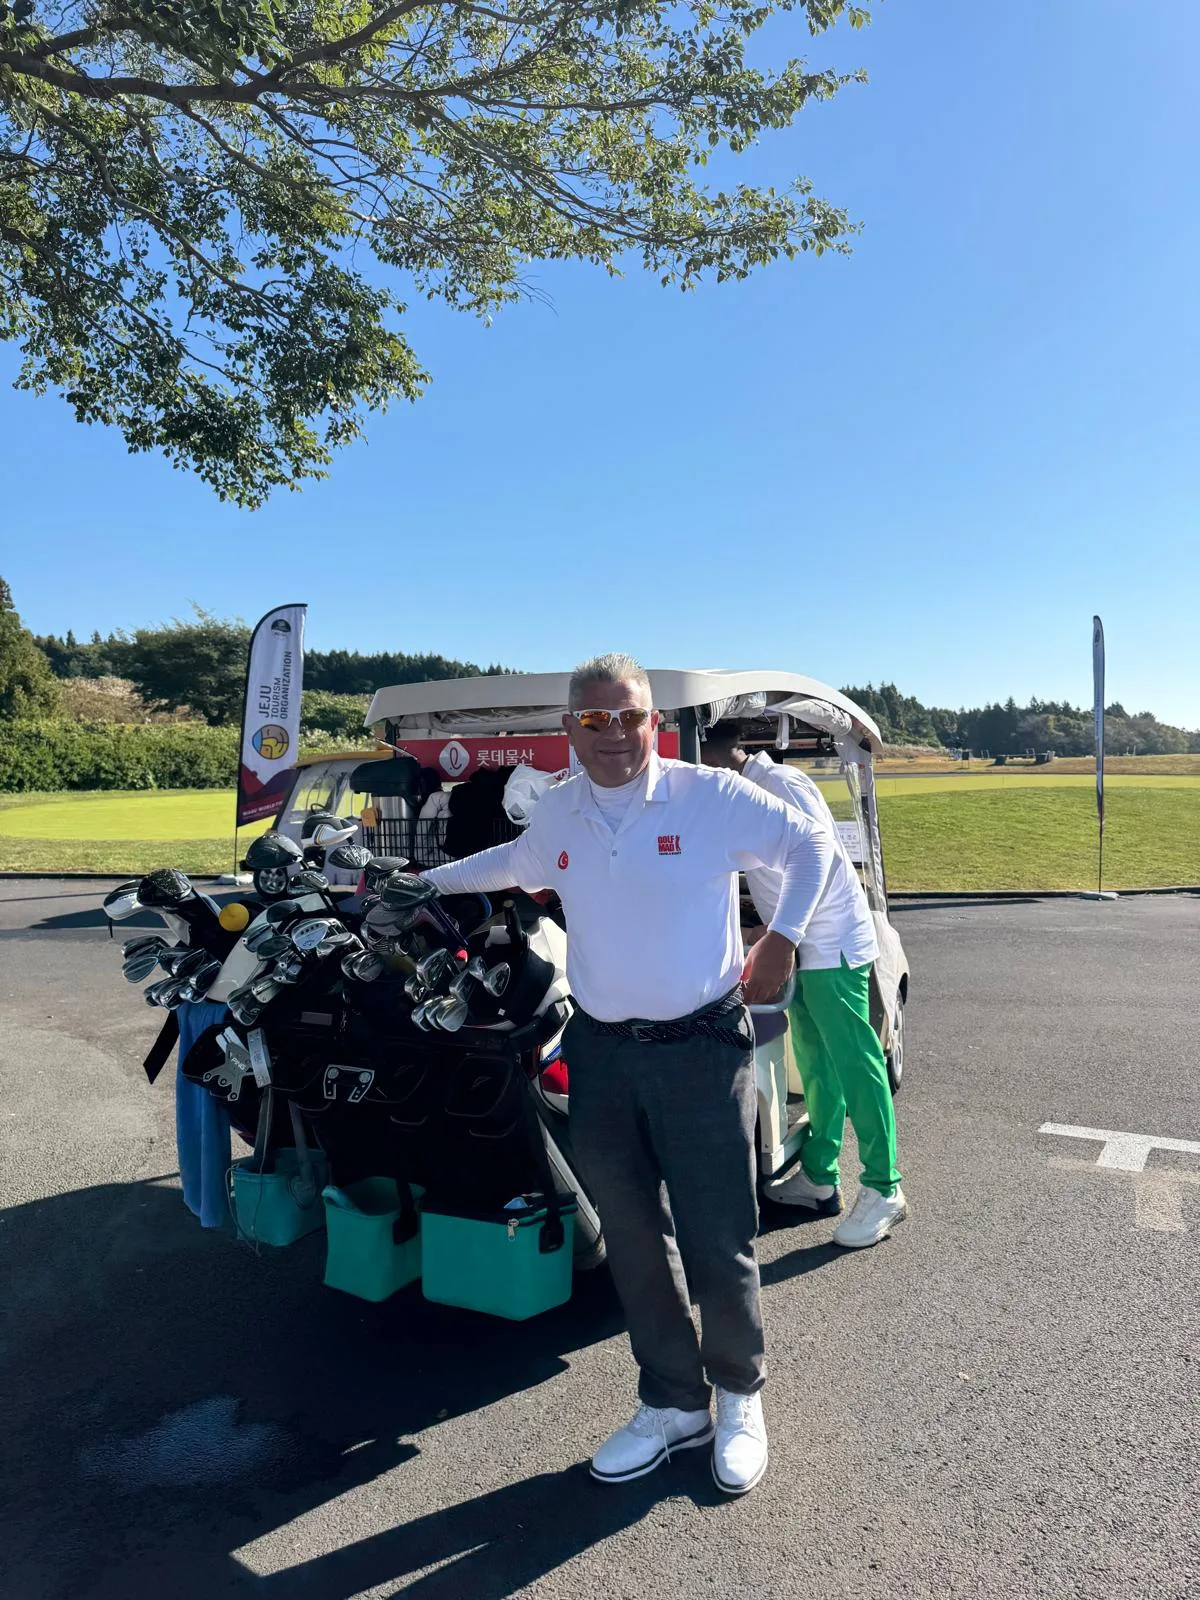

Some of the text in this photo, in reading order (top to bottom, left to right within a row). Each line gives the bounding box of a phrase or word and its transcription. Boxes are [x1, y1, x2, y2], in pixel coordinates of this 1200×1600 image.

[270, 677, 281, 719] TOURISM
[280, 651, 292, 720] ORGANIZATION
[259, 685, 271, 718] JEJU
[476, 748, 535, 767] 롯데물산
[657, 835, 675, 844] GOLF
[658, 843, 675, 852] MAD
